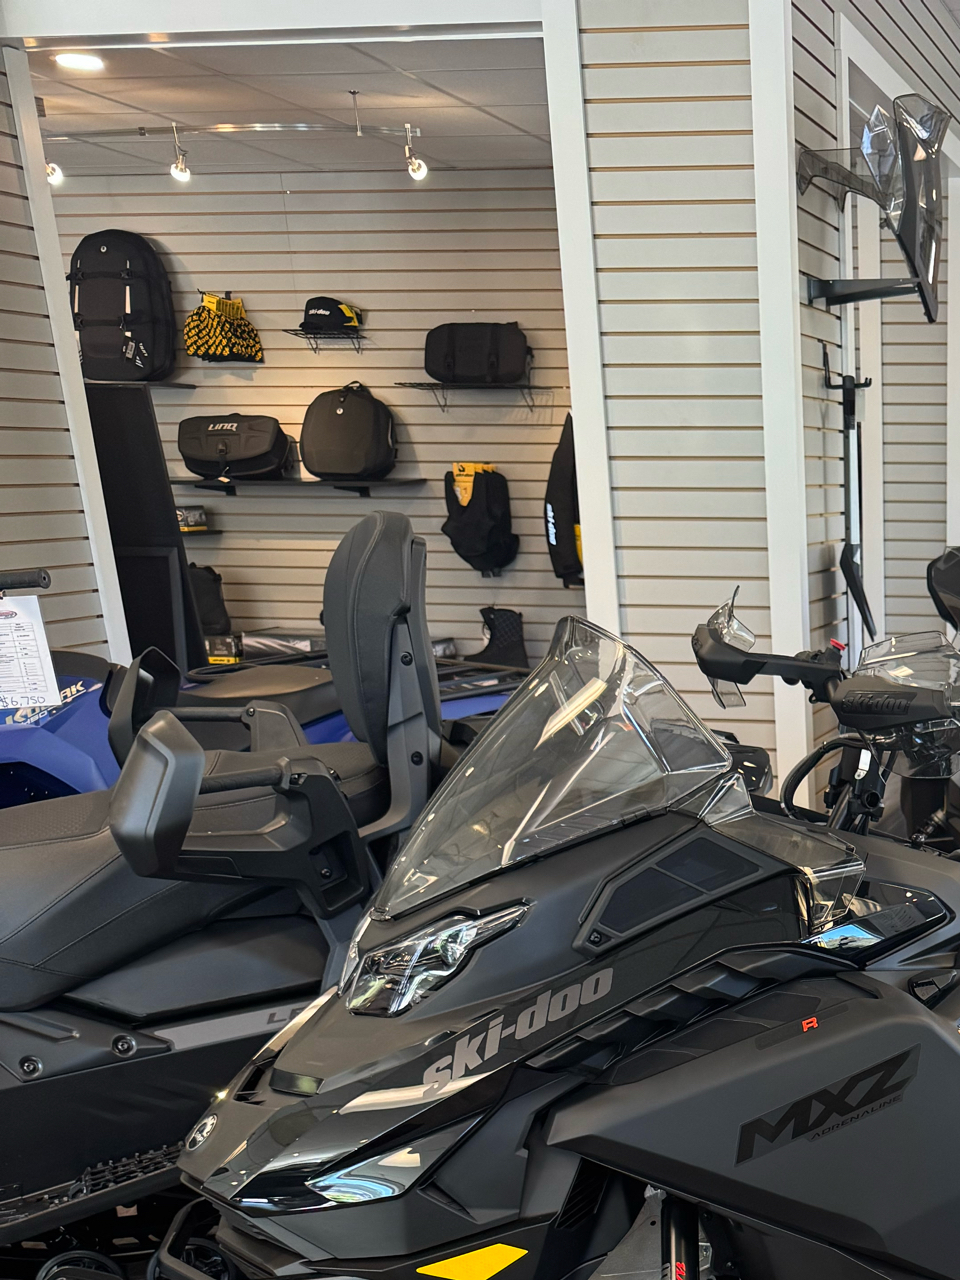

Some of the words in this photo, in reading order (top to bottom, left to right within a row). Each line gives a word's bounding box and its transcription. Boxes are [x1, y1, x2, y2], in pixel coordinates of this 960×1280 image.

[422, 967, 614, 1099] ski-doo
[735, 1048, 914, 1165] MXZ
[811, 1094, 902, 1140] ADRENALINE
